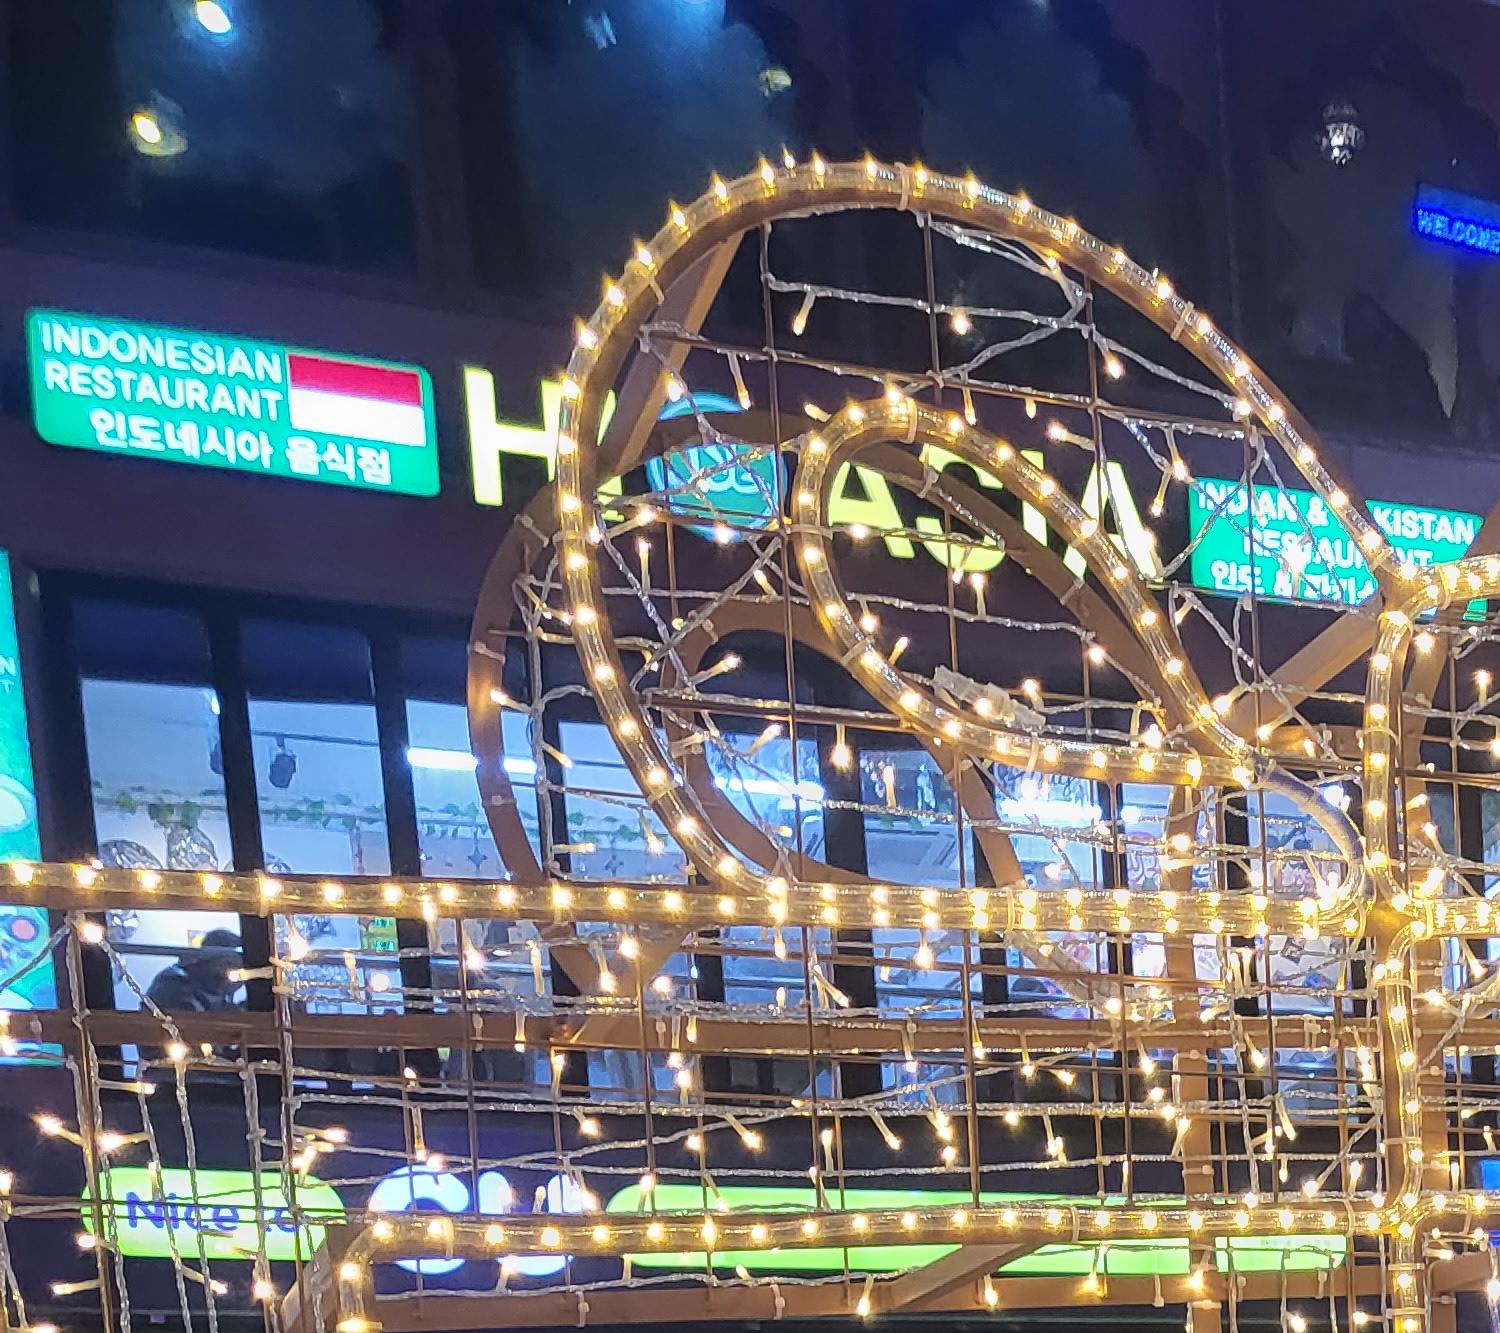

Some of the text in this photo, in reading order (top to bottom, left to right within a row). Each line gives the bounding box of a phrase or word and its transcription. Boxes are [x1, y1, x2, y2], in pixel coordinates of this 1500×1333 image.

[40, 321, 282, 383] INDONESIAN
[44, 360, 283, 422] RESTAURANT
[89, 407, 391, 486] 인도네시아 음식점
[1306, 496, 1329, 527] &
[125, 1192, 240, 1231] Nice
